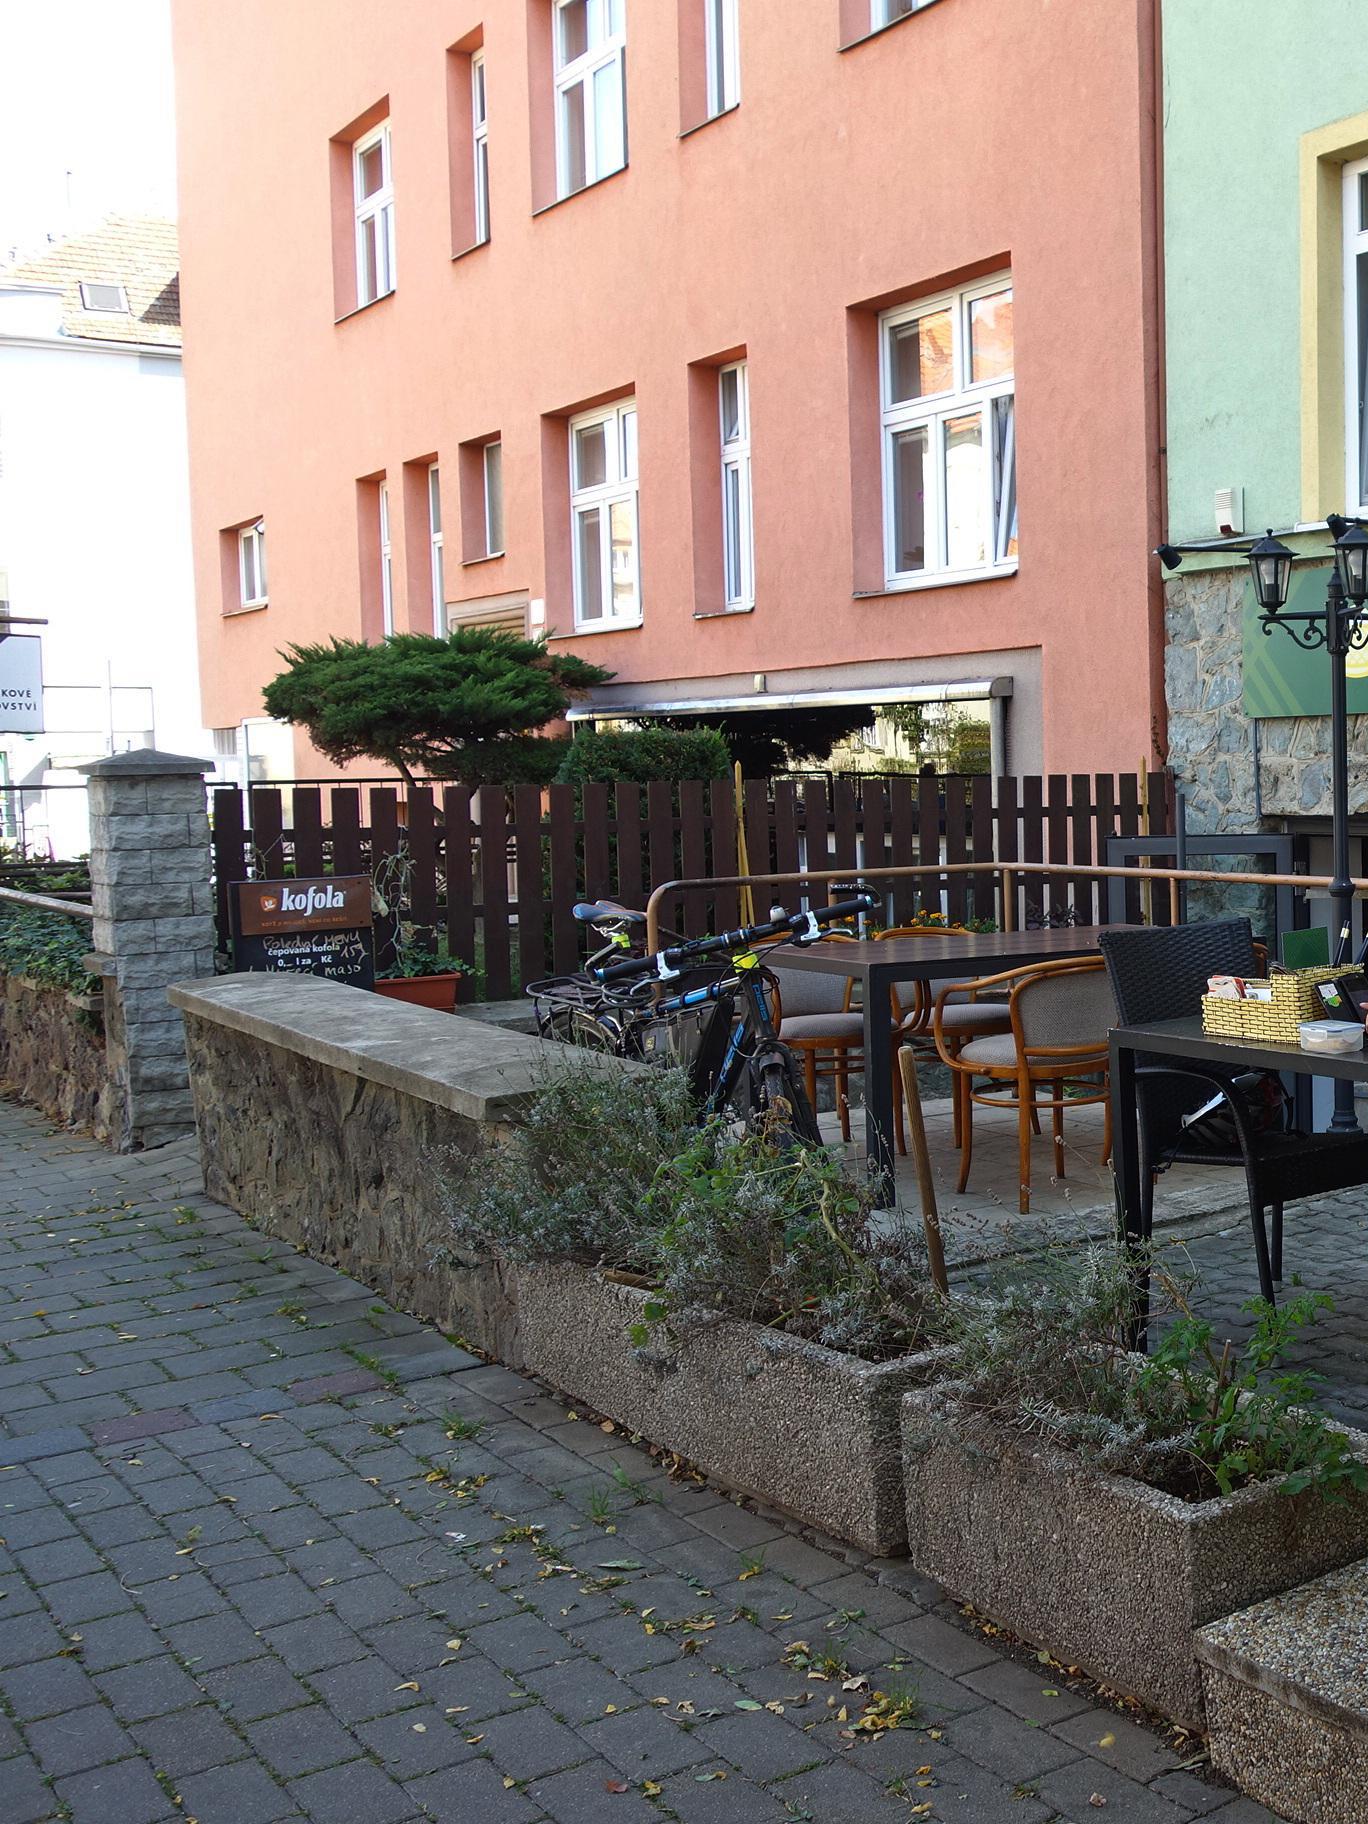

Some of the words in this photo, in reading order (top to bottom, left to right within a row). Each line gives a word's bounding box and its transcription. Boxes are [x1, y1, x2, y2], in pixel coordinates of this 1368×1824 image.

[281, 885, 344, 917] kofola
[312, 943, 340, 953] kofola
[321, 955, 332, 963] Kč
